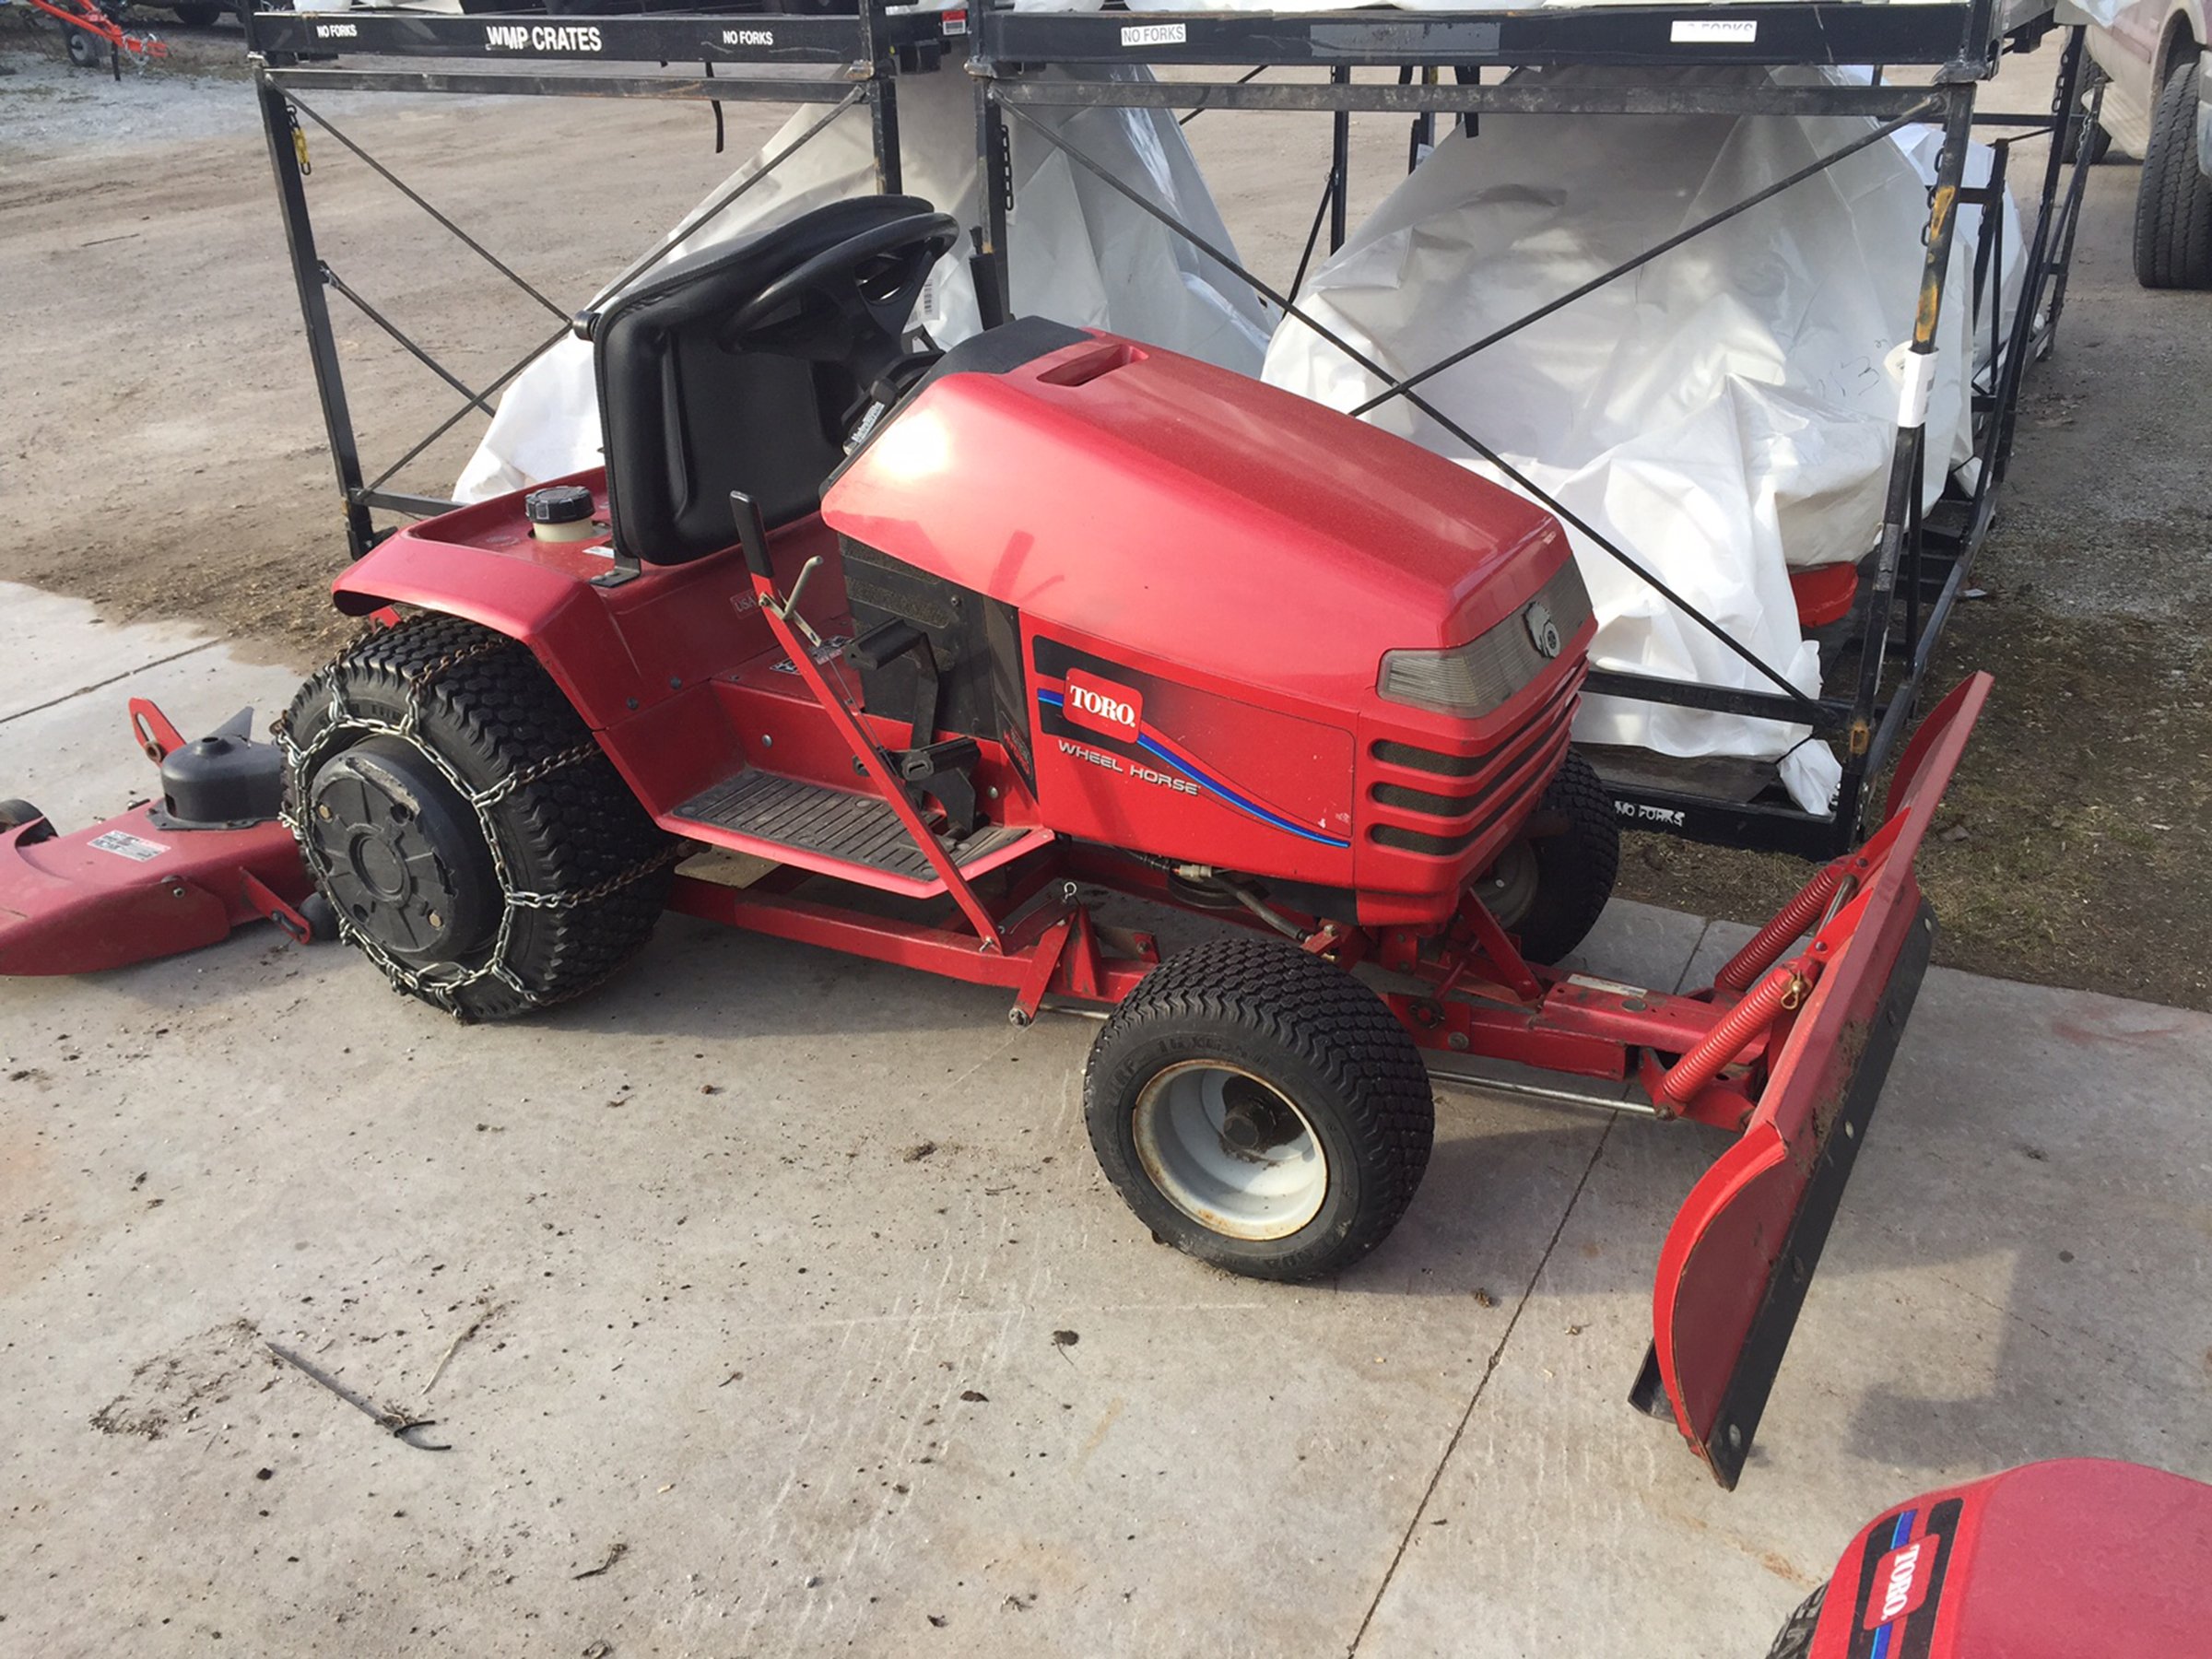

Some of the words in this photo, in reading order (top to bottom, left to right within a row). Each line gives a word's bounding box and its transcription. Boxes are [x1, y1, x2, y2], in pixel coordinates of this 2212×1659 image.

[316, 24, 330, 38] NO
[329, 23, 358, 38] FORKS
[486, 26, 529, 50] WMP
[531, 26, 603, 52] CRATES
[723, 30, 738, 44] NO
[739, 30, 773, 45] FORKS
[1123, 29, 1141, 42] NO
[1144, 26, 1184, 41] FORKS
[1058, 739, 1124, 773] WHEEL
[1130, 764, 1199, 796] HORSE
[1614, 800, 1636, 818] NO
[1638, 805, 1686, 828] FORKS
